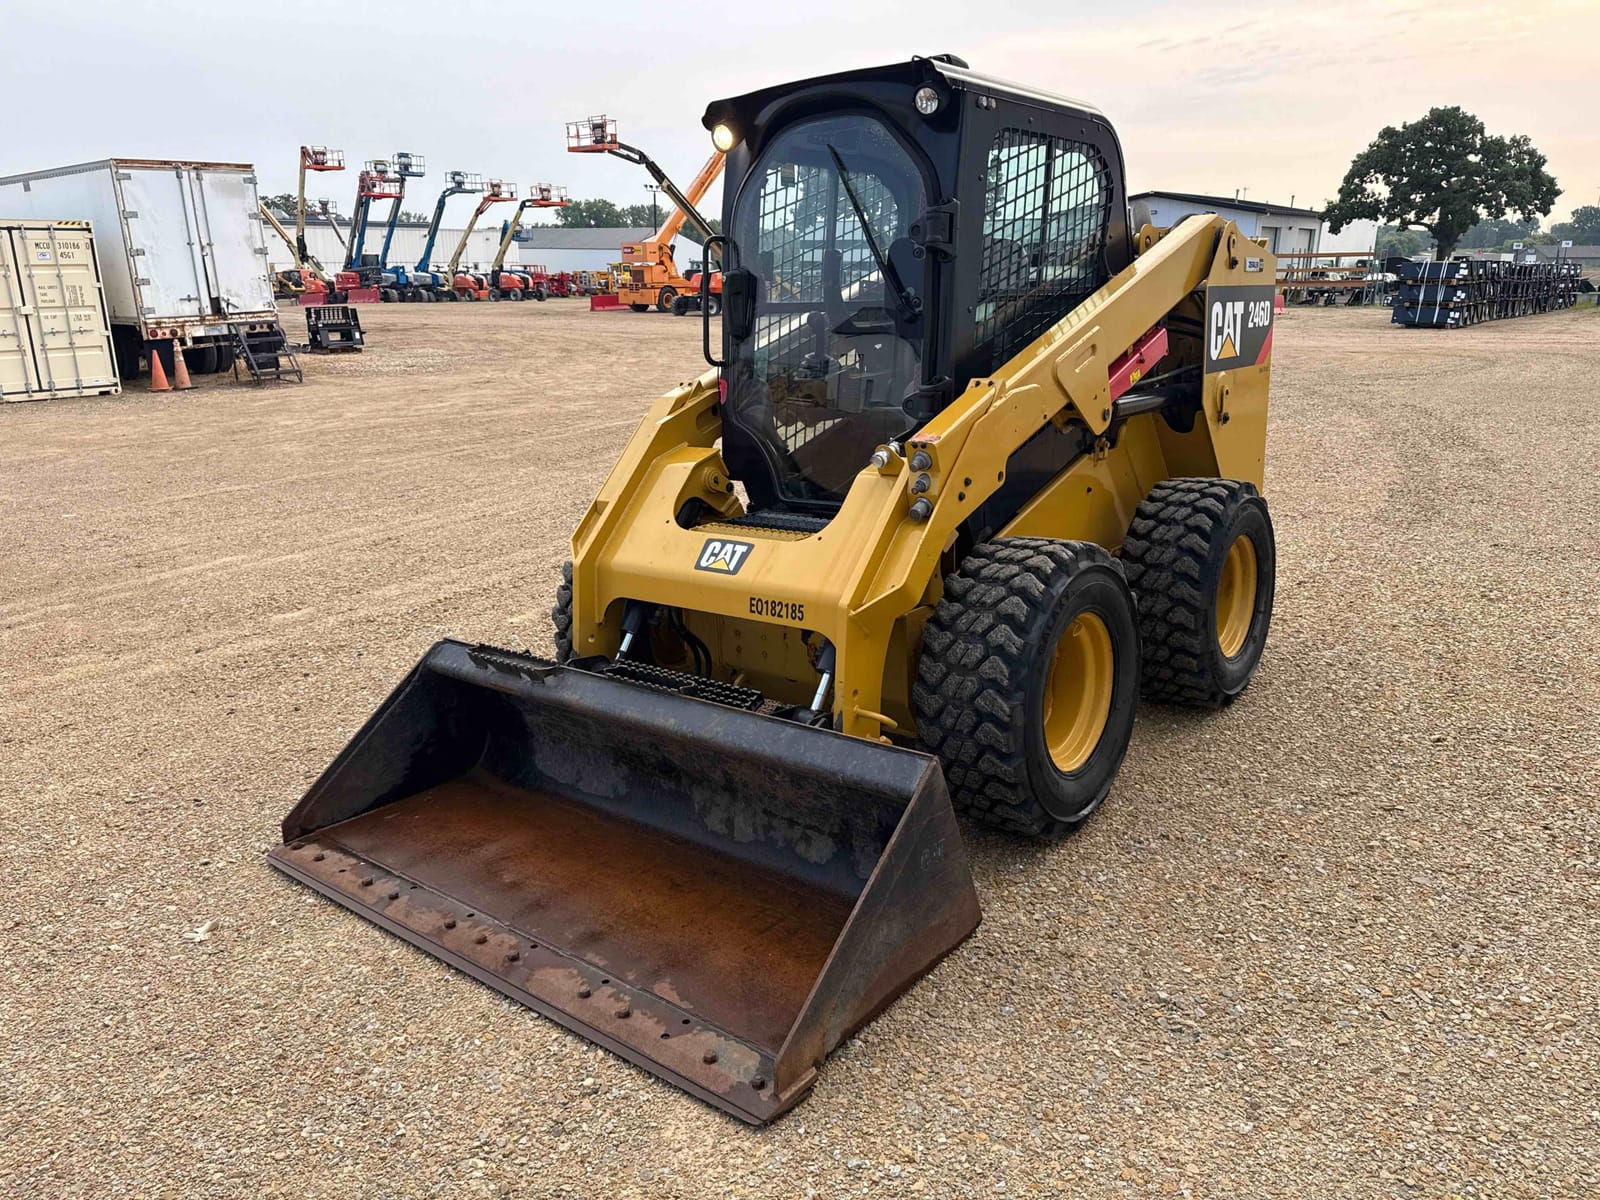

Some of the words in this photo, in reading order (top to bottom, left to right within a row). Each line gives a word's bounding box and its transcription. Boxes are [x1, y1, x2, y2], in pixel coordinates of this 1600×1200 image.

[34, 241, 50, 250] MCCU
[57, 241, 80, 250] 310186
[60, 251, 74, 259] 45G1
[1211, 301, 1244, 360] CAT
[1248, 301, 1270, 328] 246D
[700, 541, 747, 571] CAT
[749, 597, 804, 621] EQ182185
